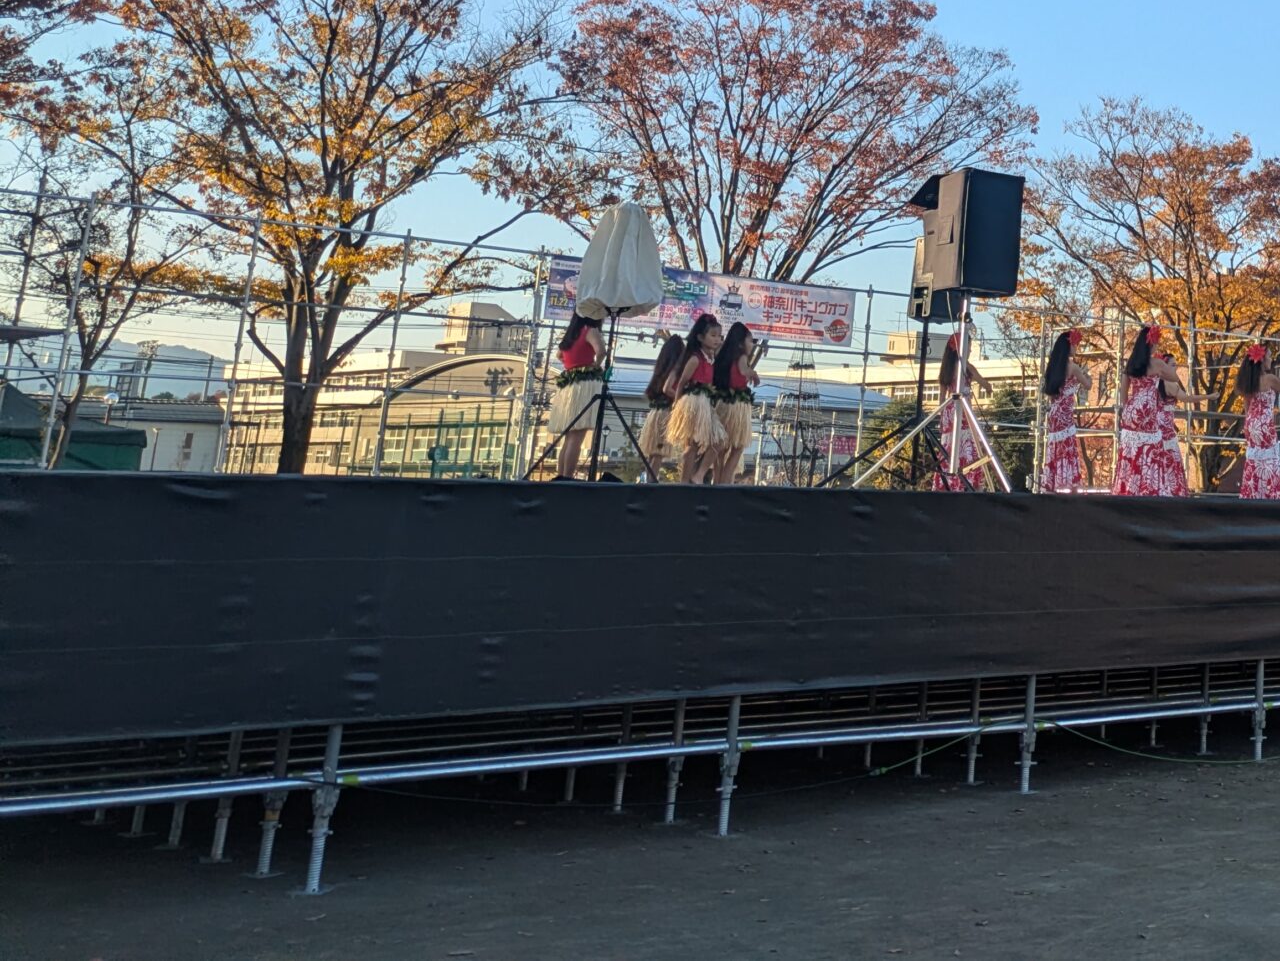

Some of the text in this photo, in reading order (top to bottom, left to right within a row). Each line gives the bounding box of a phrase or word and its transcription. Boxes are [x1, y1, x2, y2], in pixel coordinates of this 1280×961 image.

[763, 295, 849, 316] 神奈川キングオブ
[762, 309, 823, 327] キッチンカー
